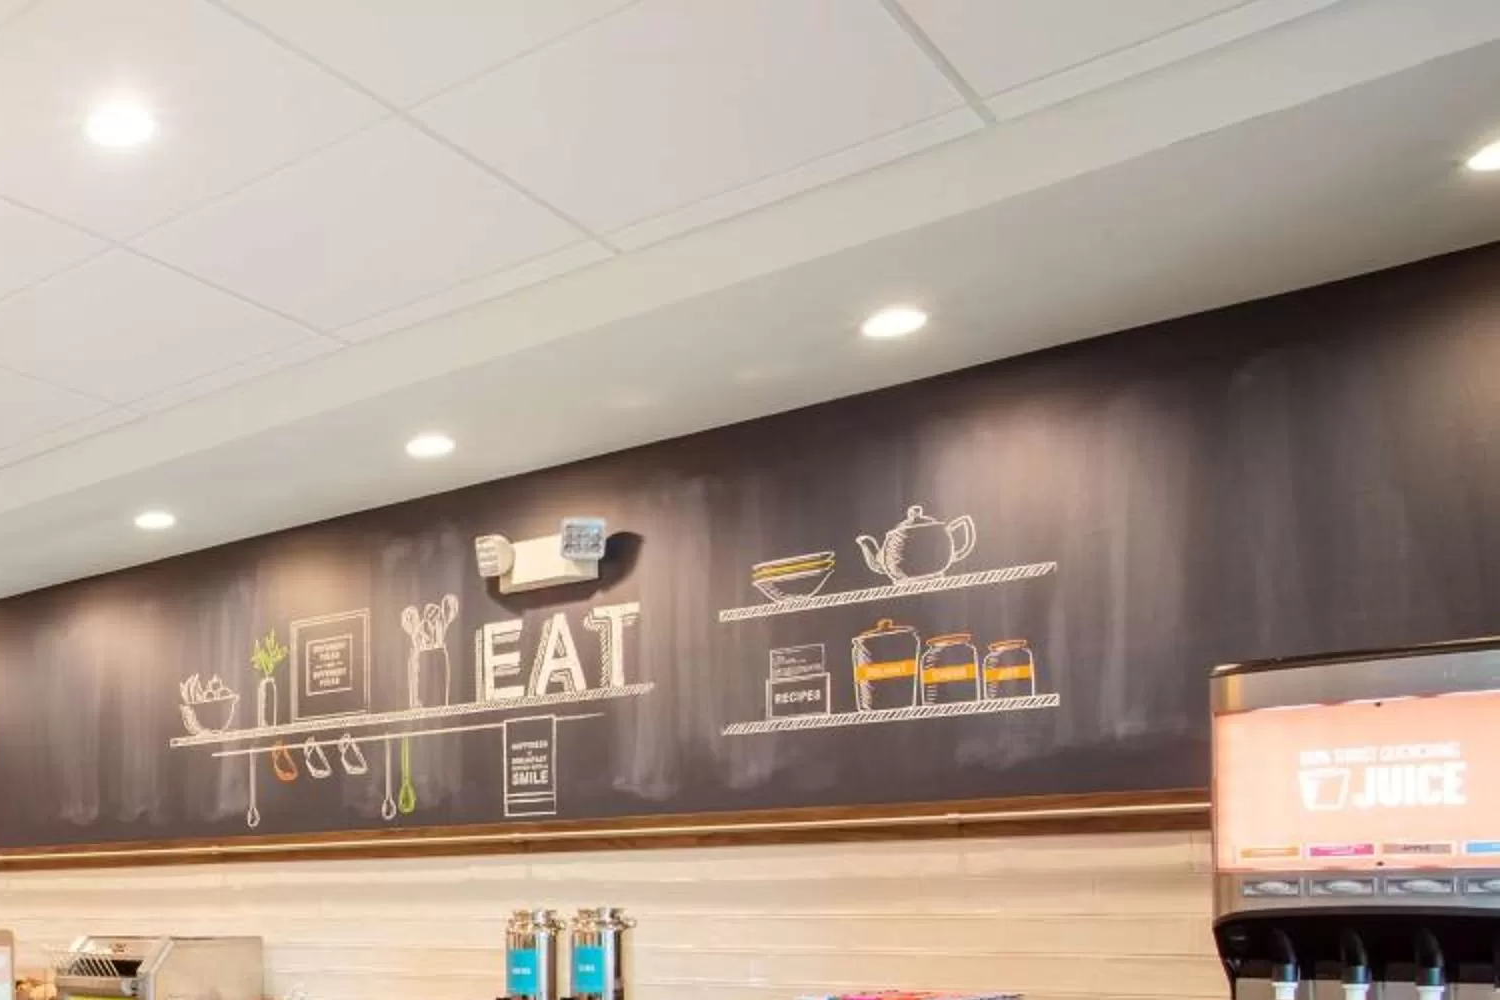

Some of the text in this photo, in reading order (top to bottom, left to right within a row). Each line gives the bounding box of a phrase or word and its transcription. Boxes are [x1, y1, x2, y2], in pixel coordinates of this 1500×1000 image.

[475, 602, 641, 703] EAT
[774, 689, 821, 704] RECIPES
[511, 769, 548, 786] SMILE
[1351, 761, 1468, 808] JUICE
